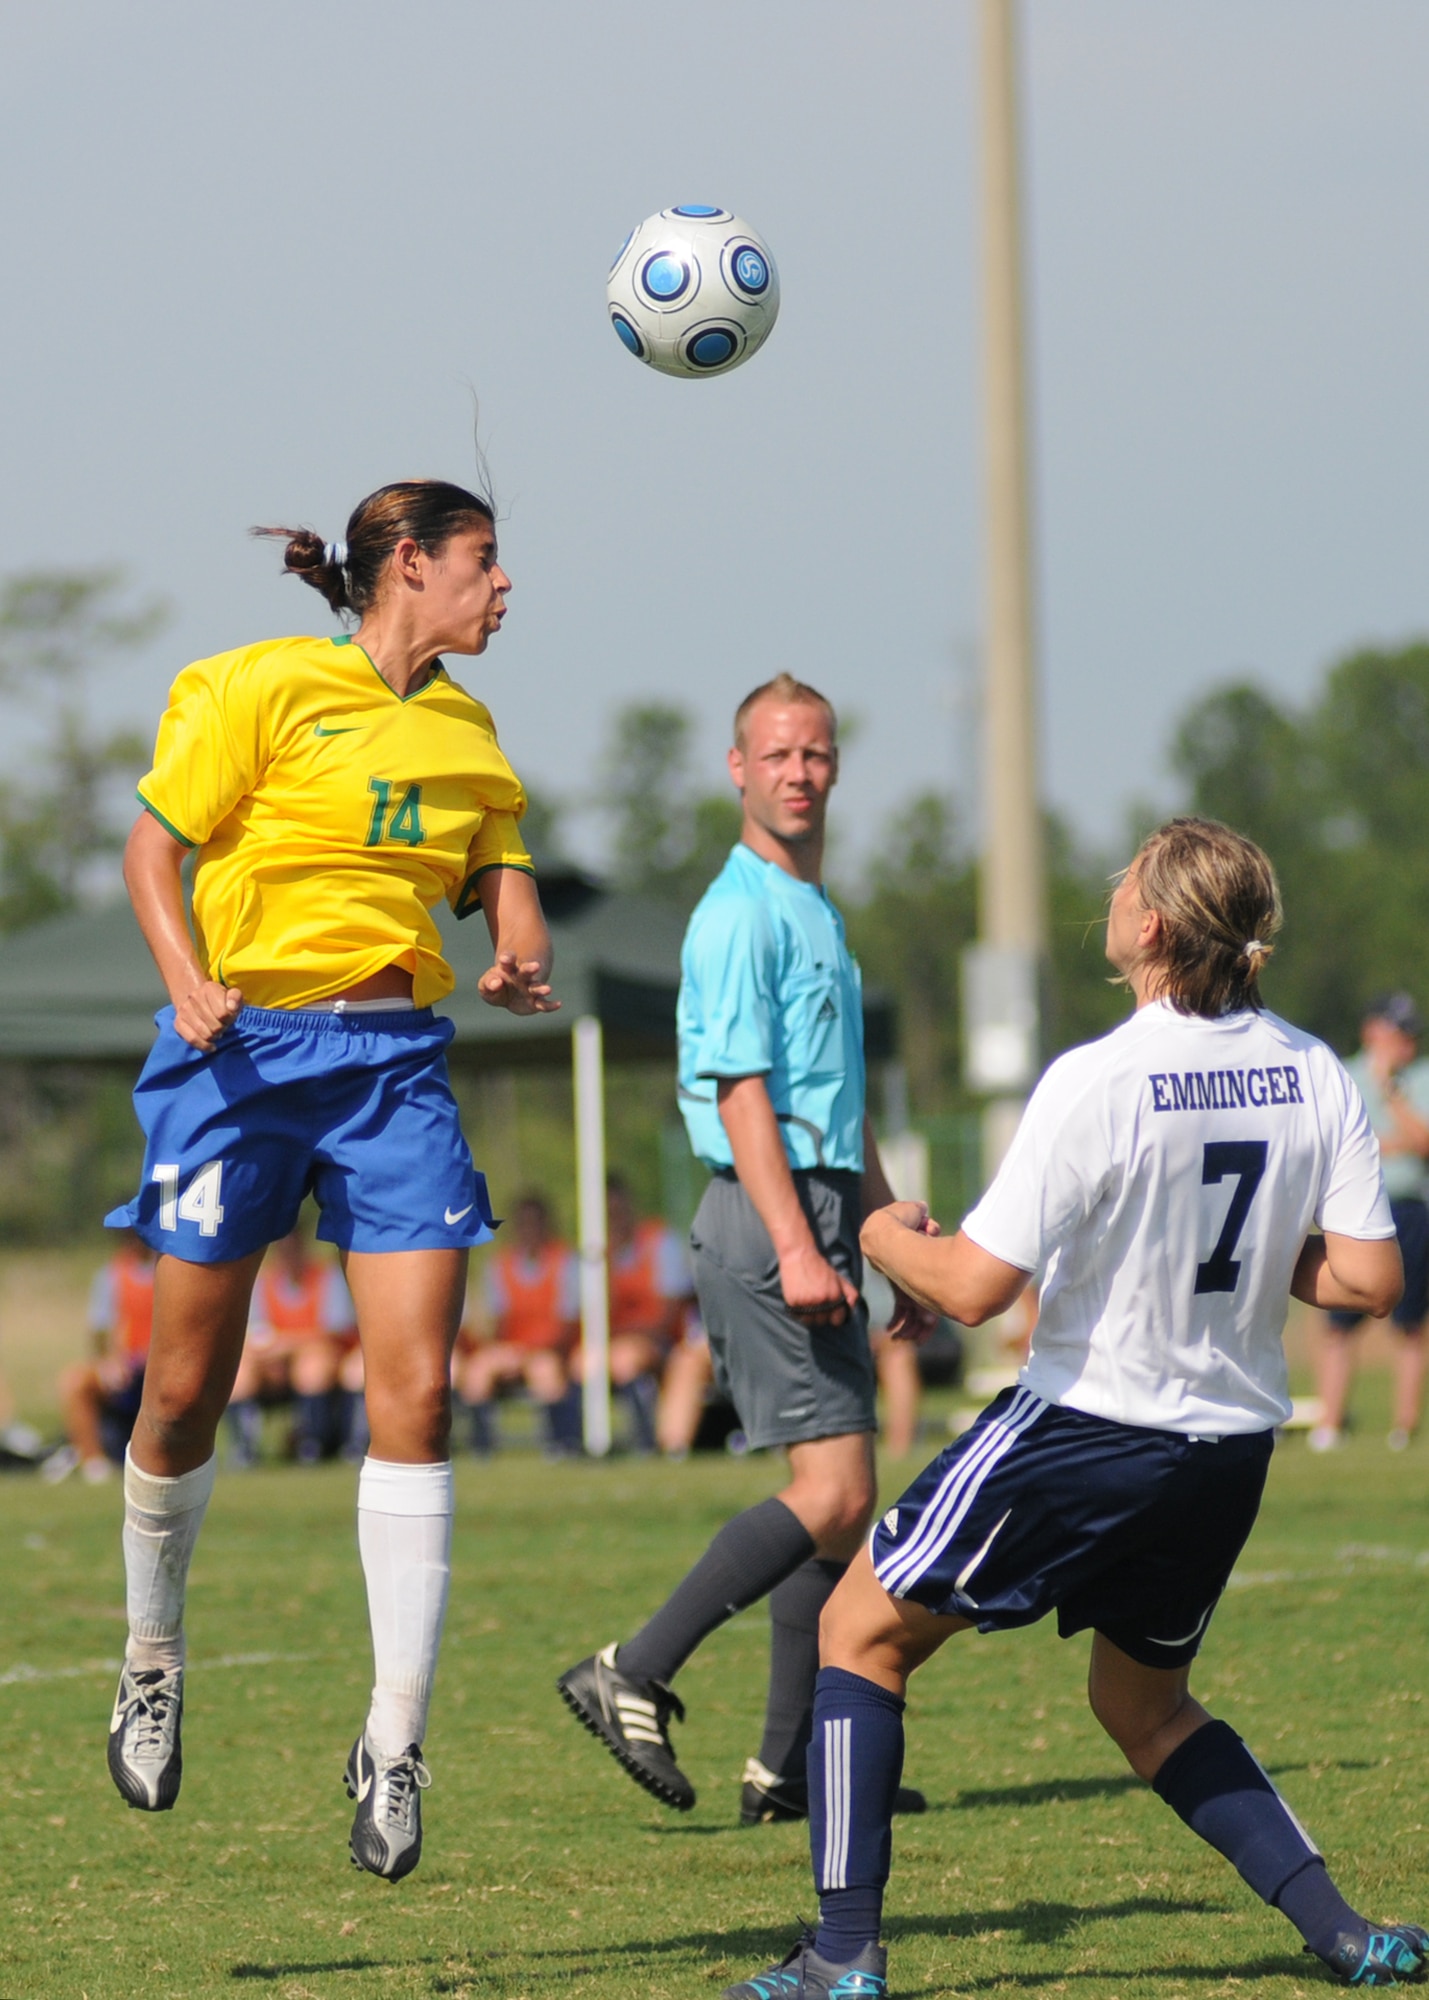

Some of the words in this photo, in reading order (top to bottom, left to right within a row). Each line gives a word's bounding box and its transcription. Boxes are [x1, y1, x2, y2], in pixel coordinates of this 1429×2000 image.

[363, 776, 427, 847] 14
[1148, 1065, 1305, 1112] EMMINGER
[152, 1160, 224, 1237] 14
[1194, 1140, 1269, 1295] 7
